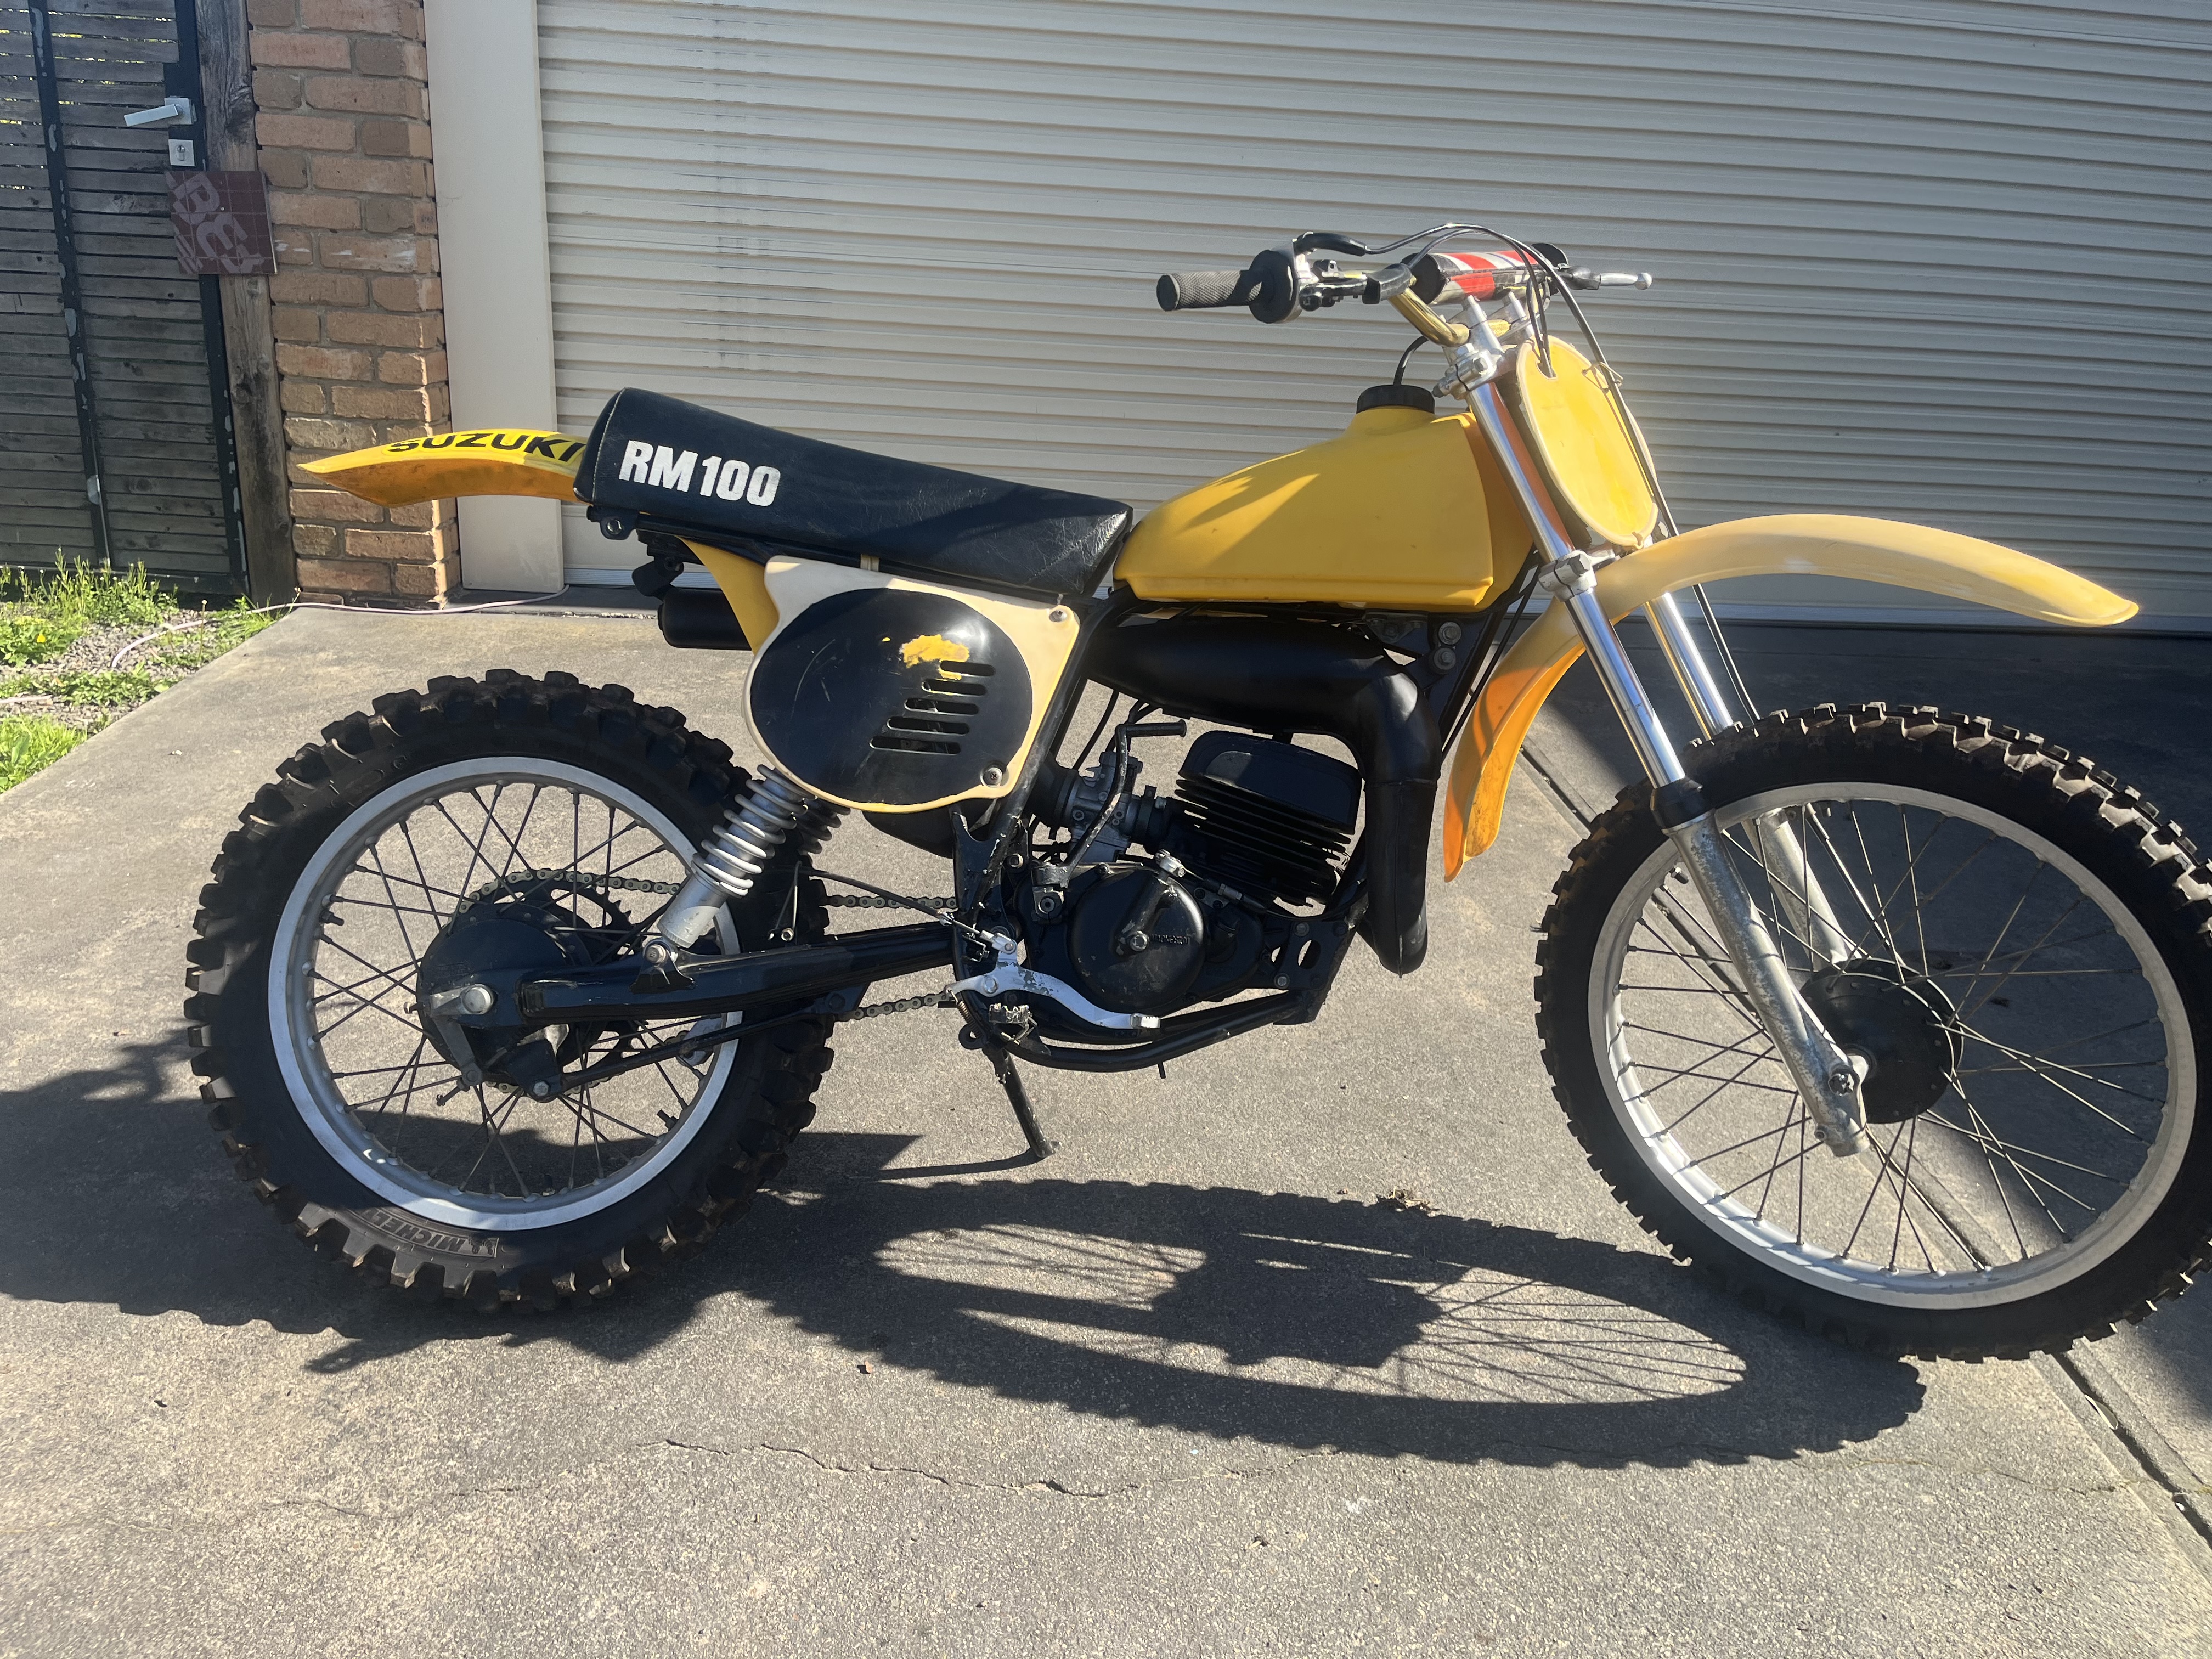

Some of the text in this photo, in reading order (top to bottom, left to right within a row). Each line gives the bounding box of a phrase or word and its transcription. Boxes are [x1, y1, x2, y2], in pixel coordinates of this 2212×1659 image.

[387, 433, 586, 462] SUZUKI
[618, 439, 781, 507] RM 100
[359, 1207, 466, 1252] MICHELI
